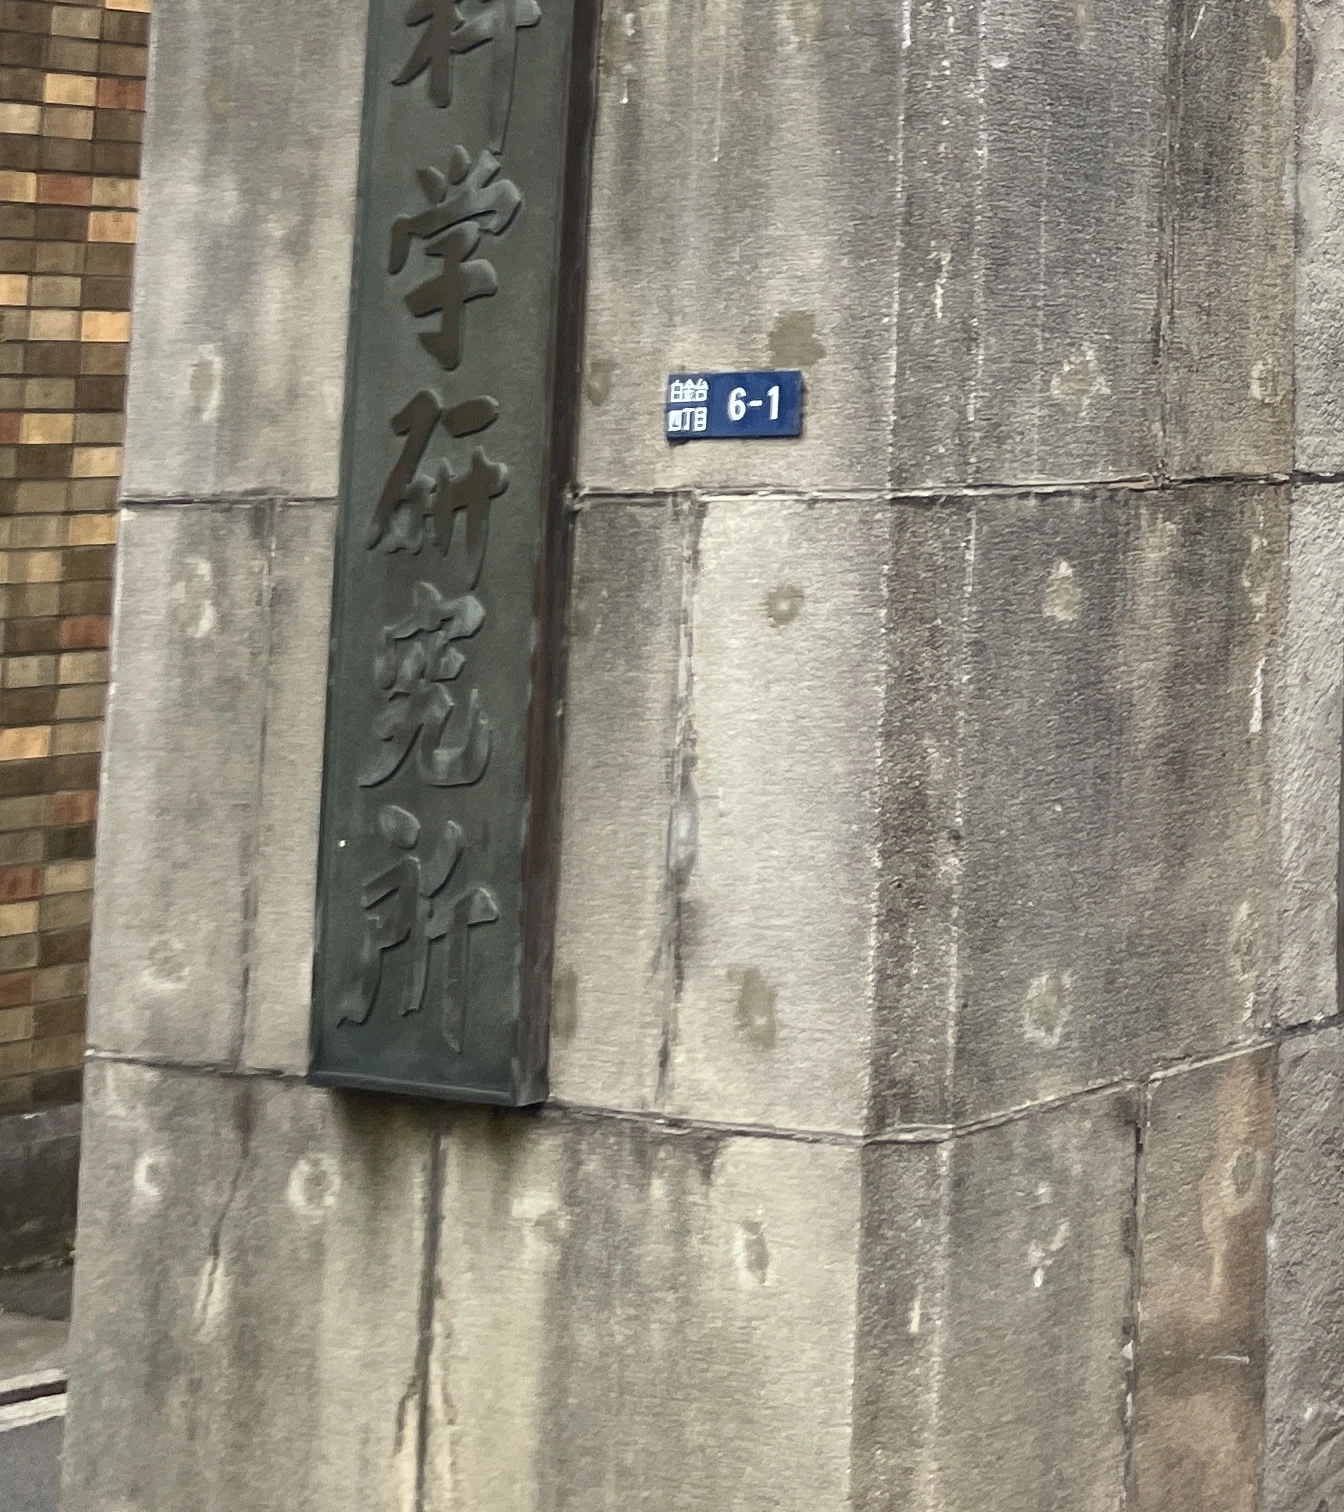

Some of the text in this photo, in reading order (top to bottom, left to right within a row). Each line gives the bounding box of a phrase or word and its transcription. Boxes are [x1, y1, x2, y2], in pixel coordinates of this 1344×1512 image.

[670, 378, 709, 403] 白金台
[727, 385, 780, 422] 6-1
[667, 406, 708, 432] 四丁目
